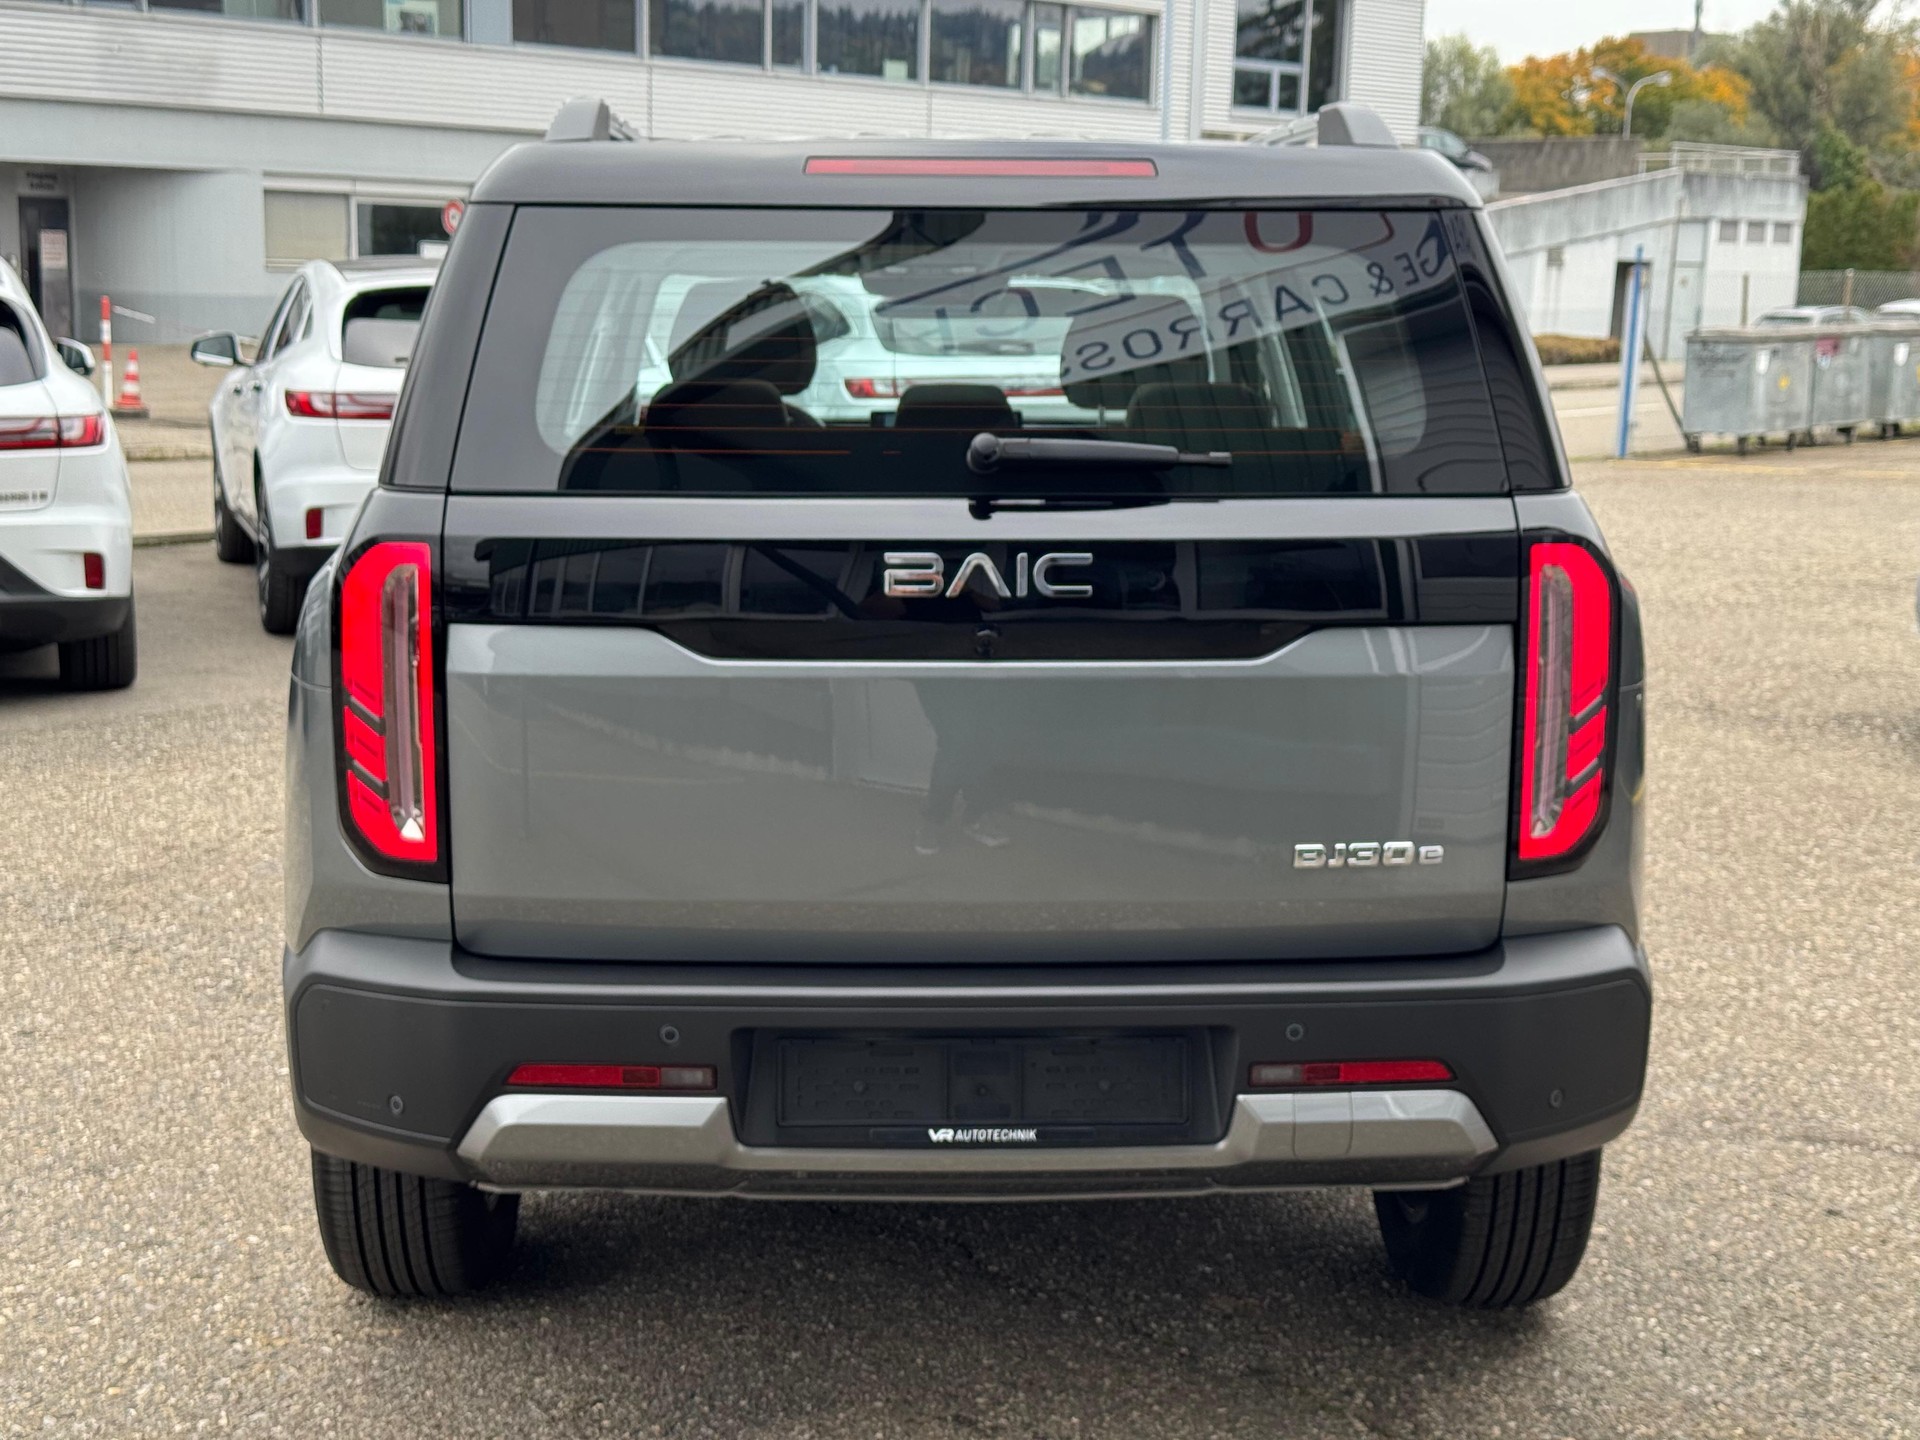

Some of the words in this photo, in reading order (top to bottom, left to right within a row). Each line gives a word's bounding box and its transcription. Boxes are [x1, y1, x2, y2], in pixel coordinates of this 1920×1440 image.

[884, 552, 1093, 598] BAIC
[1294, 841, 1444, 868] BJ30e
[928, 1128, 954, 1142] VR
[954, 1128, 1037, 1142] AUTOTECHNIK
